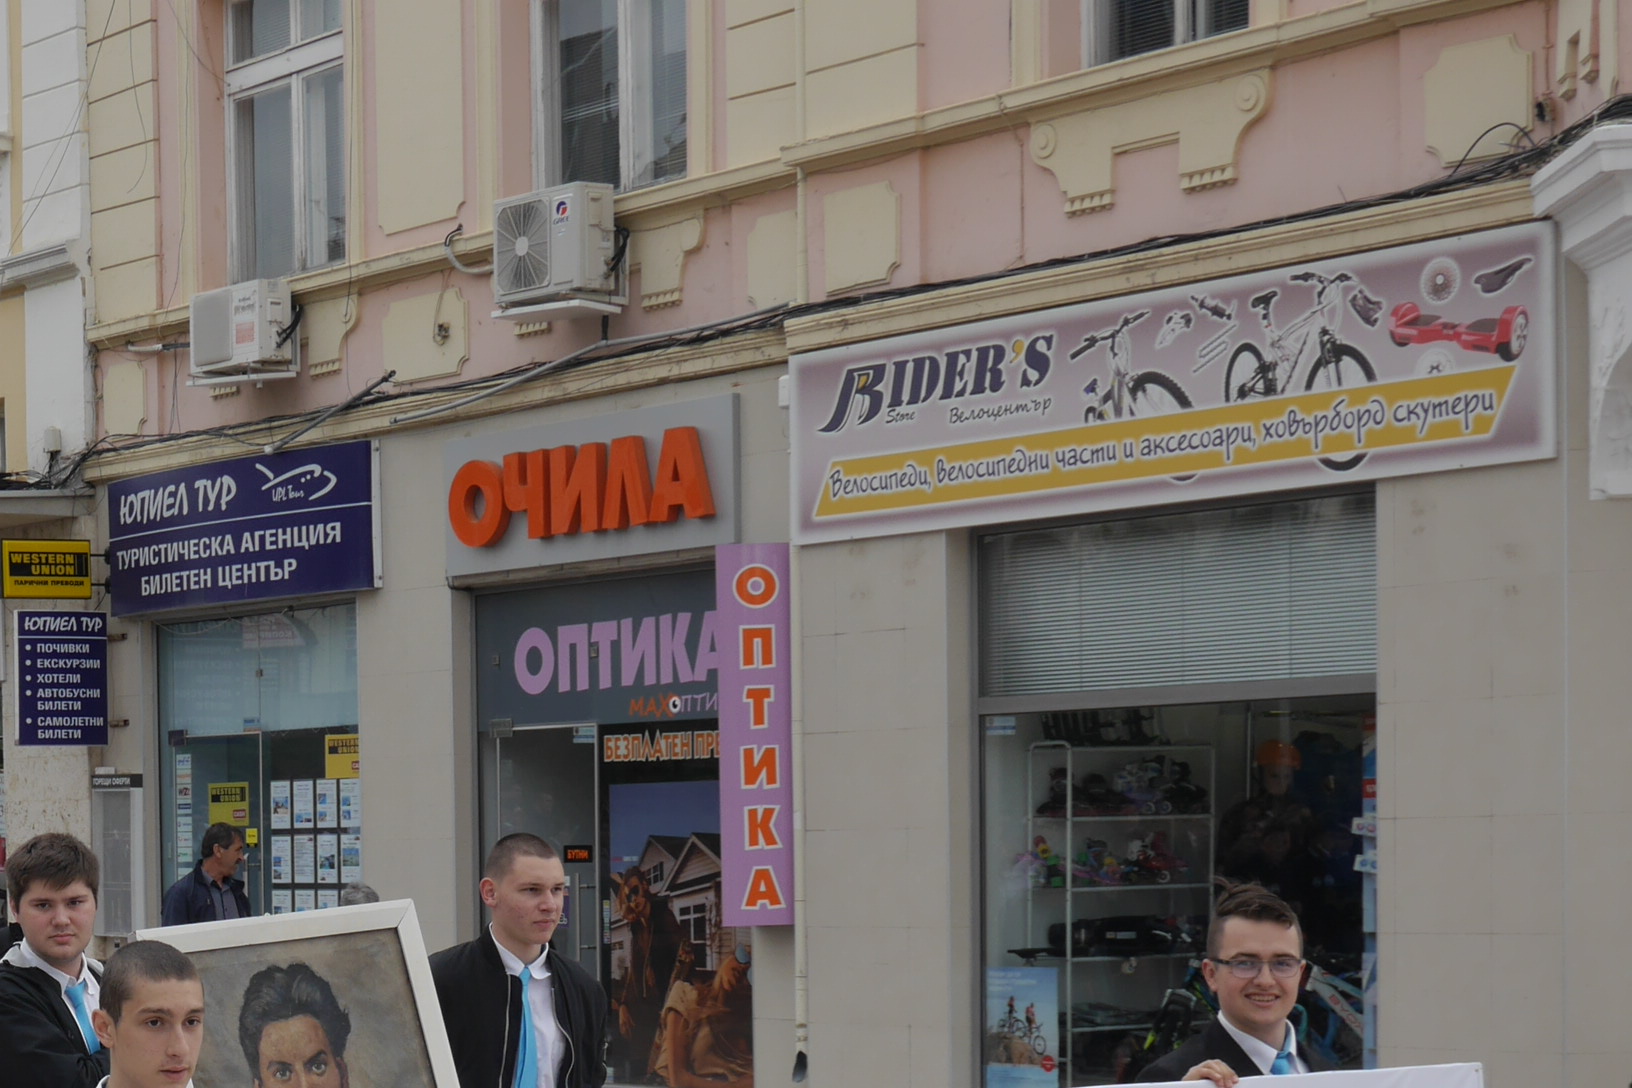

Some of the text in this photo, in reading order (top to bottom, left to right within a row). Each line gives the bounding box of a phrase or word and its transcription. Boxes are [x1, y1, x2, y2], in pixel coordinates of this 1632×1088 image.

[818, 334, 1054, 433] RIDER'S
[885, 397, 1052, 427] Store Велоцентър
[830, 391, 1494, 498] Велосипеди, велосипедни части и аксесоари, ховърборд скутери
[448, 426, 716, 548] ОЧИЛА
[119, 474, 237, 525] ЮПИЕЛ ТУР
[116, 521, 342, 571] ТУРИСТИЧЕСКА АГЕНЦИЯ
[10, 552, 75, 564] WESTERN
[31, 564, 75, 576] UNION
[141, 558, 297, 597] БИЛЕТЕН ЦЕНТЪР
[51, 580, 84, 588] ПРЕВОДИ
[24, 616, 102, 632] ЮПИЕЛ ТУР
[37, 644, 90, 654] ПОЧИВКИ
[514, 610, 718, 695] ОПТИКА
[37, 659, 101, 670] ЕКСКУРЗИИ
[37, 674, 81, 684] ХОТЕЛИ
[37, 688, 101, 698] АВТОБУСНИ
[38, 701, 82, 711] БИЛЕТИ
[38, 716, 104, 727] САМОЛЕТНИ
[38, 729, 82, 740] БИЛЕТИ
[732, 562, 786, 911] ОПТИКА
[604, 729, 692, 762] БЕЗПЛАТЕН
